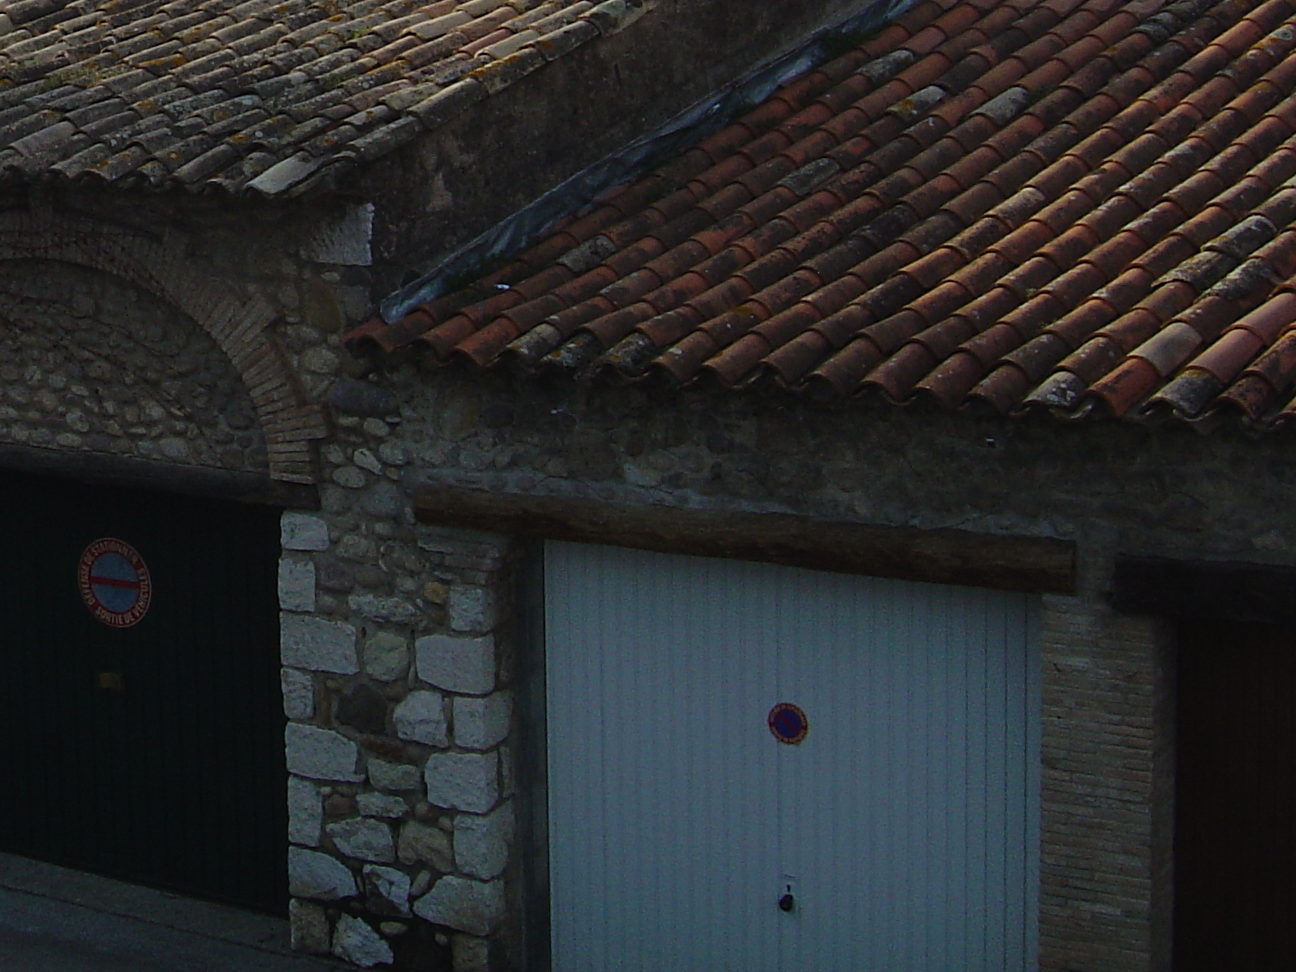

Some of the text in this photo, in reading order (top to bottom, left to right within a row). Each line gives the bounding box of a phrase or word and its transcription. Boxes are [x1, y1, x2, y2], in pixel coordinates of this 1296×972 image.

[95, 567, 149, 625] SORTIE DE VEHICULES
